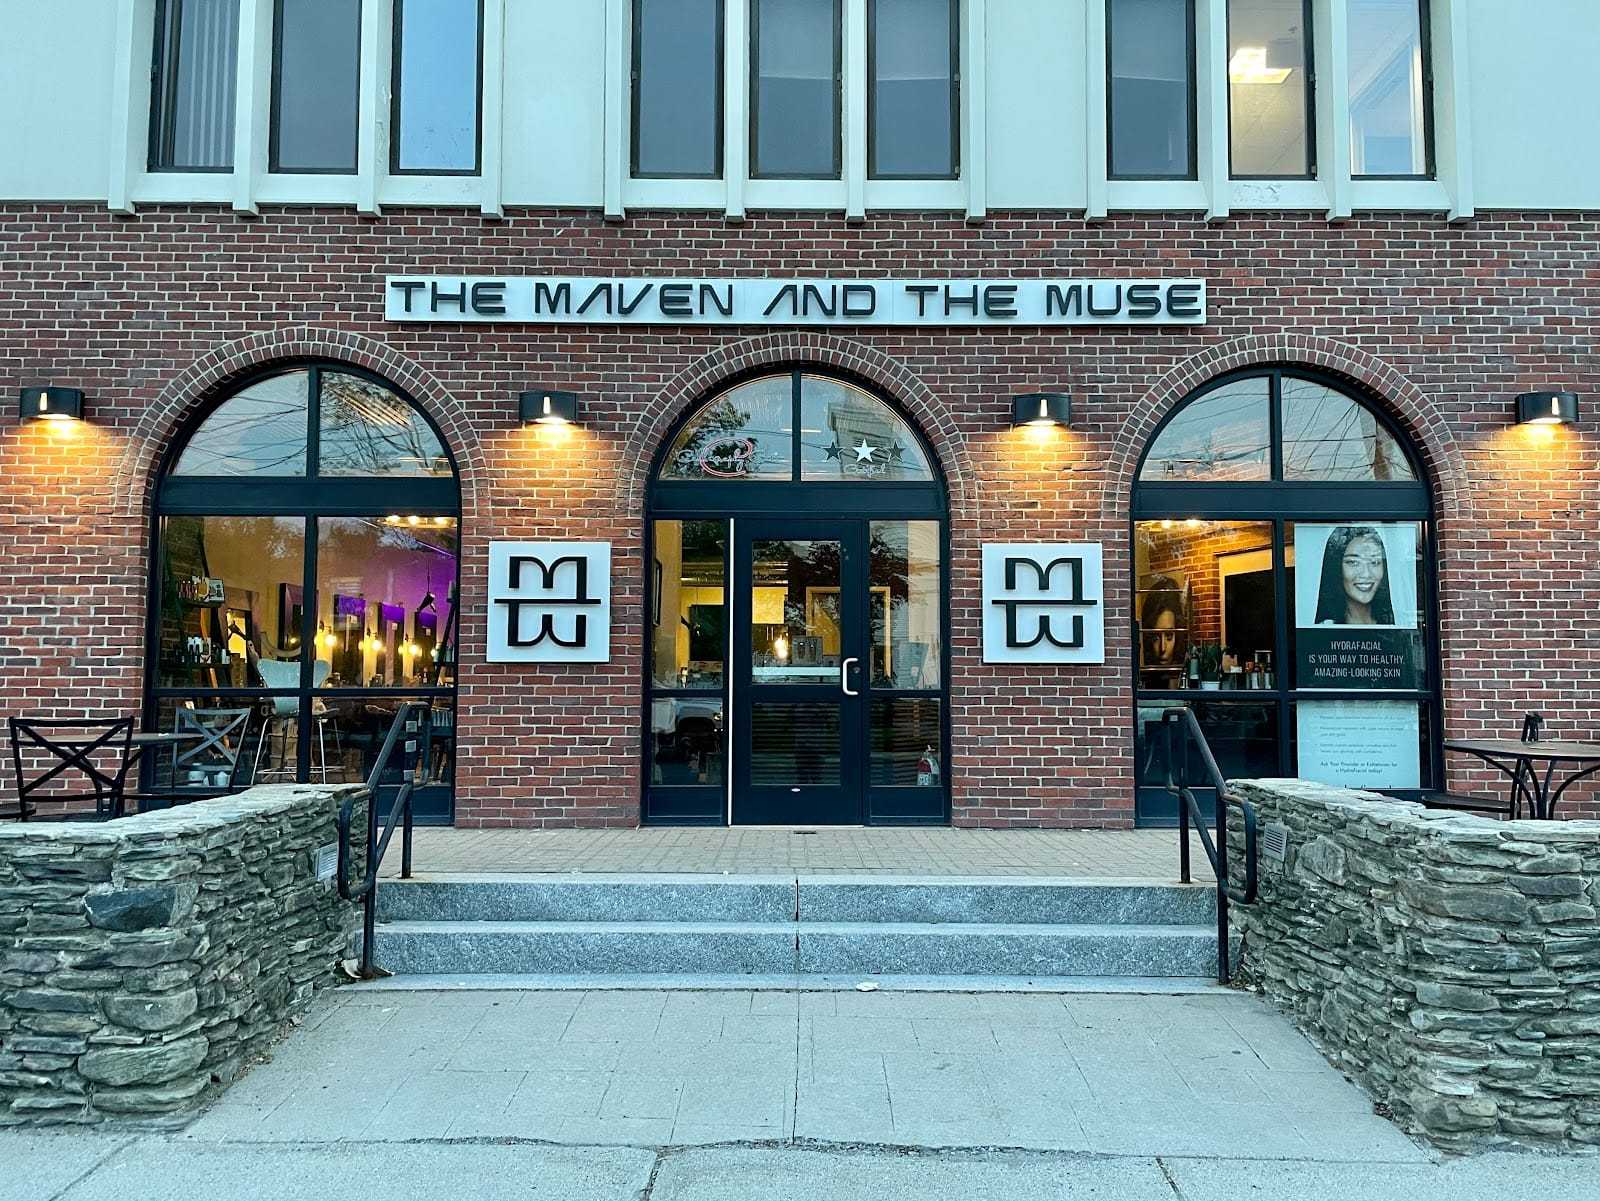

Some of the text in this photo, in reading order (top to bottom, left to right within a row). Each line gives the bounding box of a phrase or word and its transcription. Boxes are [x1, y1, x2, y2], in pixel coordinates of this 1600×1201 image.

[390, 281, 1203, 317] THE MAVEN AND THE MUSE
[1330, 641, 1382, 651] HYDRAFACIAL
[1308, 655, 1316, 664] IS
[1318, 655, 1338, 664] YOUR
[1339, 655, 1357, 665] WAY
[1359, 655, 1369, 665] TO
[1314, 668, 1401, 678] AMAZING-LOOKING SKIN
